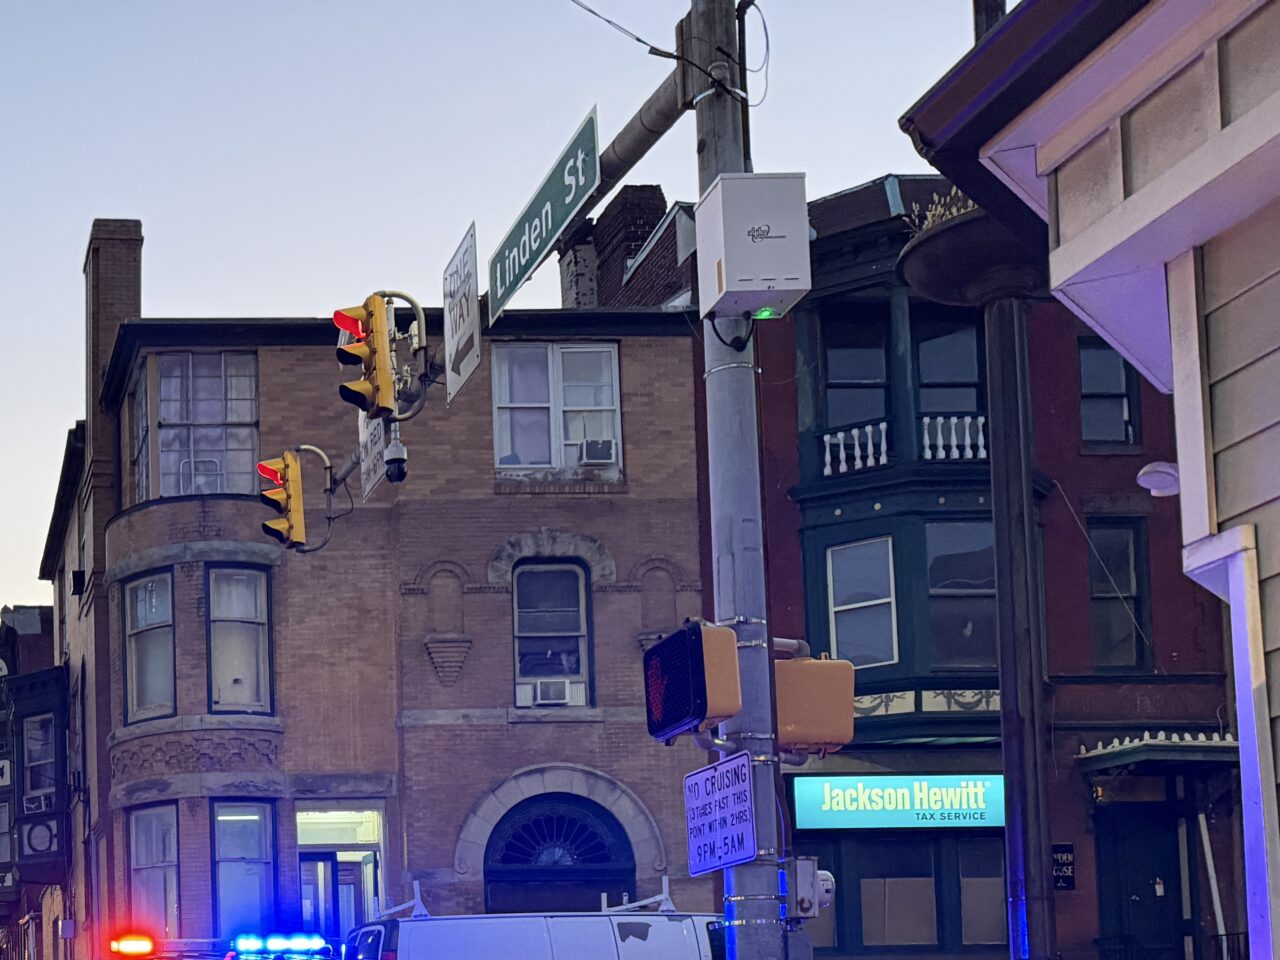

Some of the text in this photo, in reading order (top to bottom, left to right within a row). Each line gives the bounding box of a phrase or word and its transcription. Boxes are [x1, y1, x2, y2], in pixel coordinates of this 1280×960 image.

[496, 148, 586, 299] Linden St
[704, 763, 747, 796] CRUISING
[821, 780, 987, 812] Jackson Hewitt
[915, 811, 987, 821] TAX SERVICE
